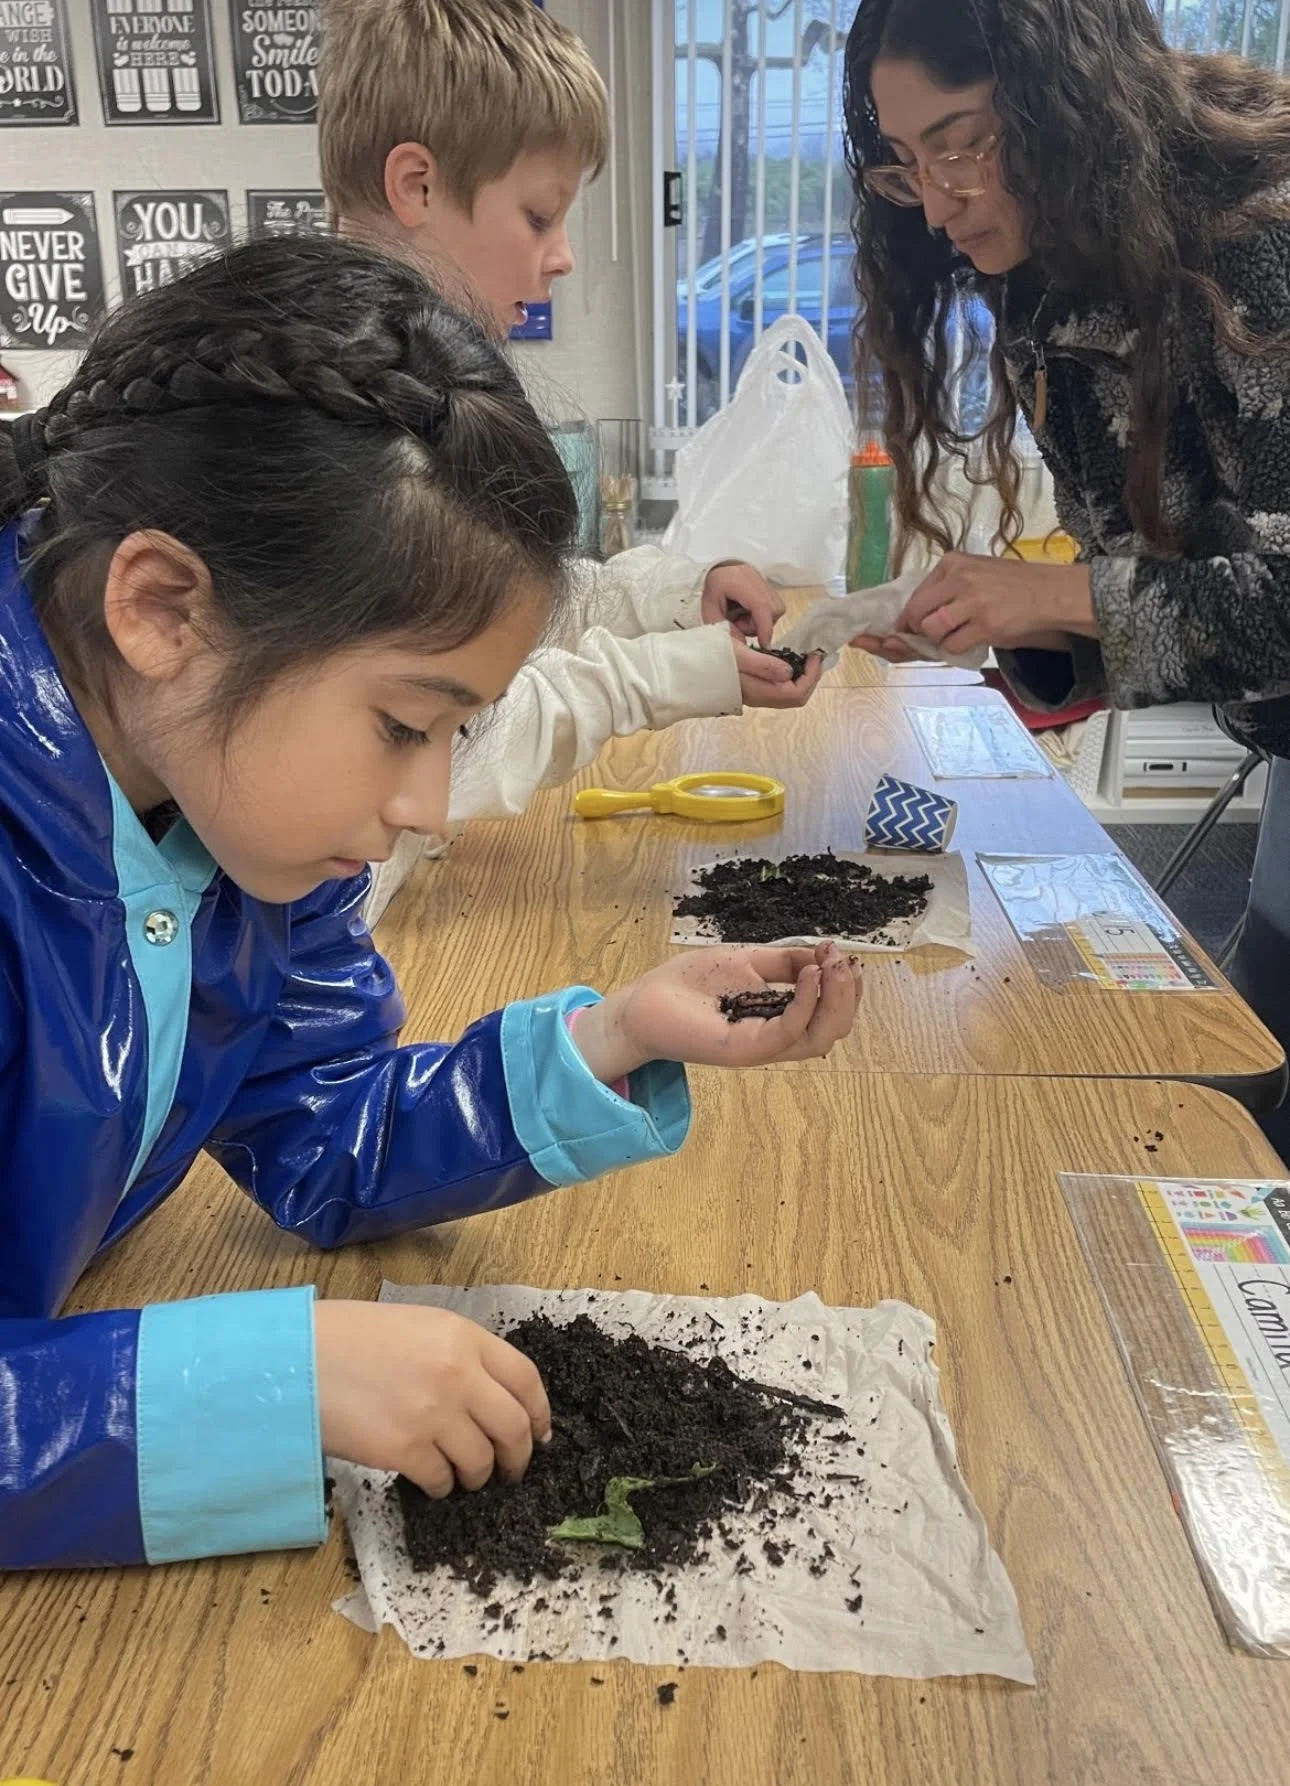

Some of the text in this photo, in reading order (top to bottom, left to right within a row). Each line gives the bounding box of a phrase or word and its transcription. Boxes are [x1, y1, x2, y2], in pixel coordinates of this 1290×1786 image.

[110, 15, 196, 34] EVERYONE
[12, 46, 29, 62] in
[33, 43, 57, 62] the
[131, 33, 191, 51] welcome
[251, 35, 319, 69] Smile
[130, 51, 180, 66] HERE
[133, 202, 203, 240] YOU
[0, 230, 85, 260] NEVER
[5, 262, 88, 301] GIVE
[28, 302, 72, 345] Up
